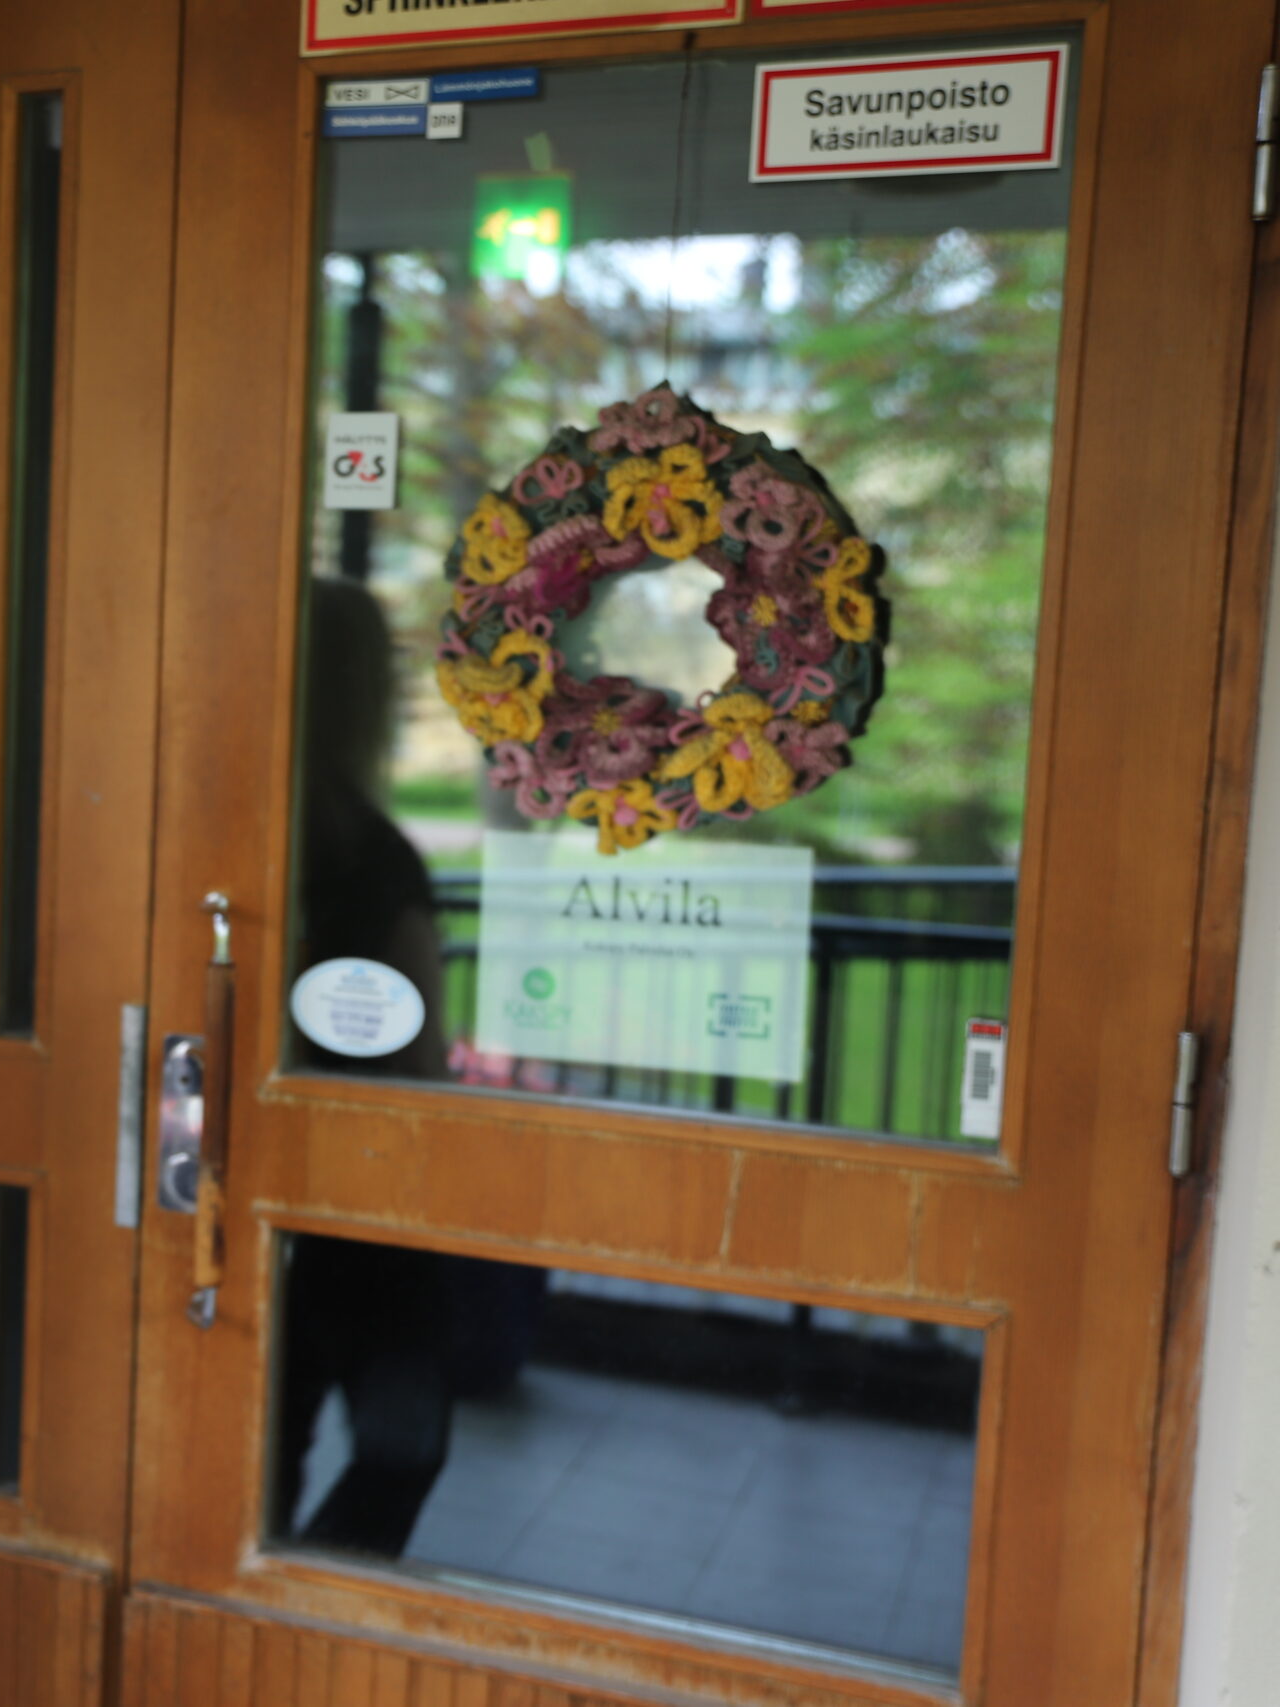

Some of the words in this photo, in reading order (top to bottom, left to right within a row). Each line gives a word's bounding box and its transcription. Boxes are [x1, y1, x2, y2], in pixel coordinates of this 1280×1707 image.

[804, 80, 1011, 119] Savunpoisto
[809, 120, 1000, 152] käsinlaukaisu
[560, 874, 723, 927] Alvila
